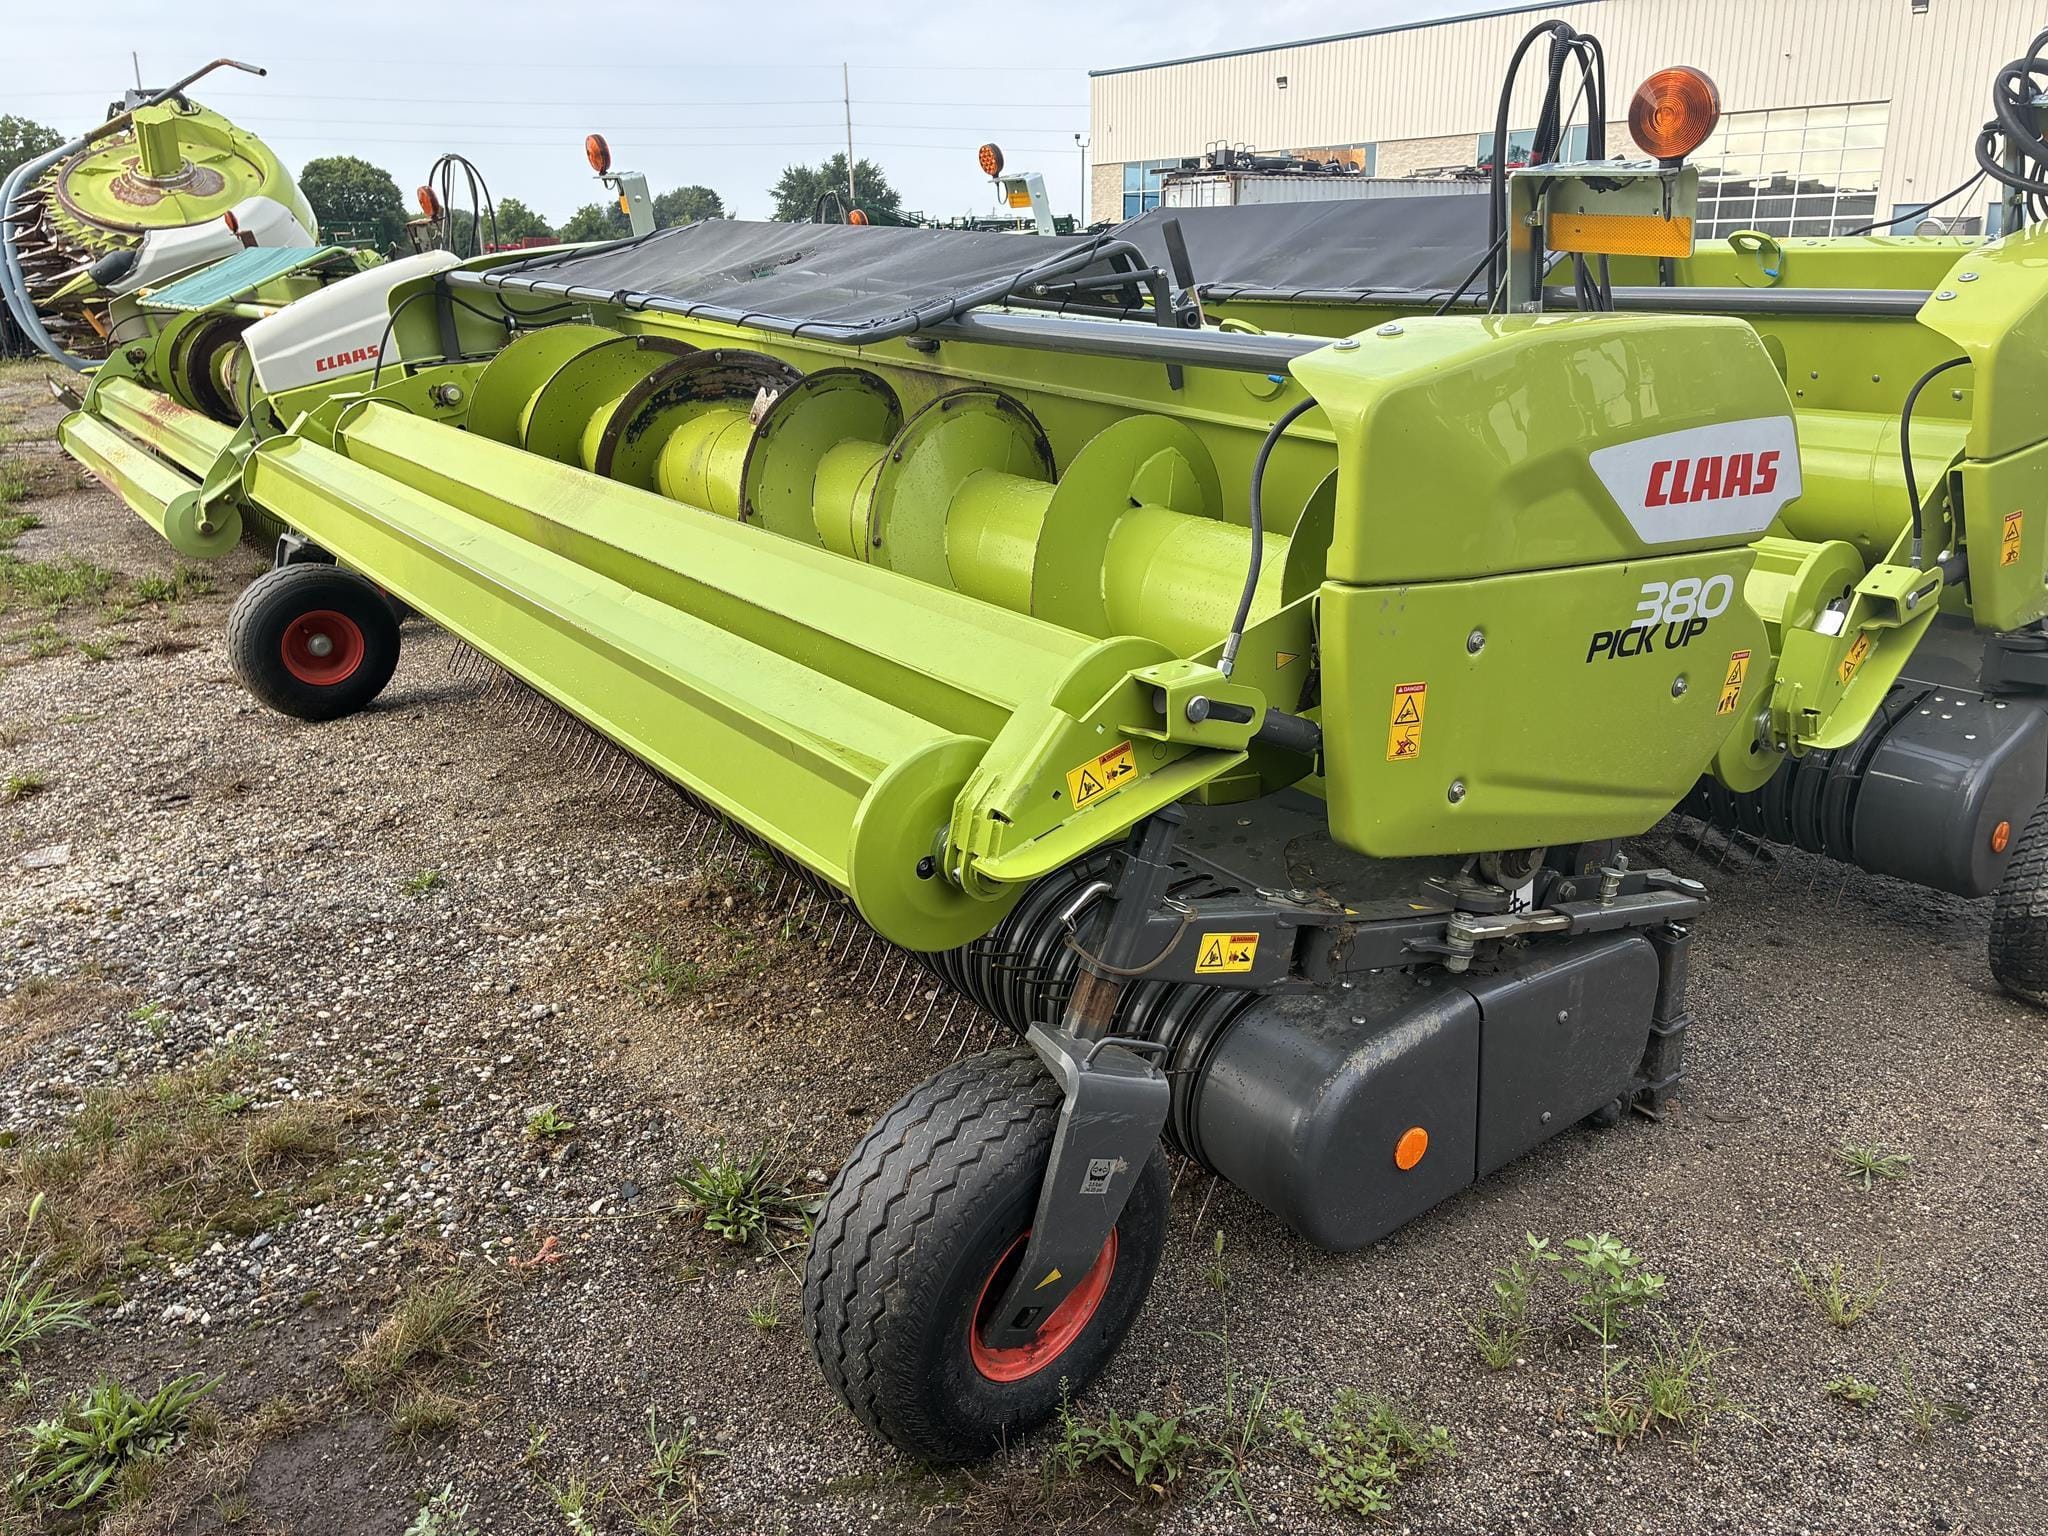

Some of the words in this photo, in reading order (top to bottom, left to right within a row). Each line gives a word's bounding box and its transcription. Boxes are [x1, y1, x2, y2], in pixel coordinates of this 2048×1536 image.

[316, 345, 379, 372] CLAAS
[1645, 451, 1780, 507] CLAAS
[1631, 574, 1734, 628] 380
[1586, 623, 1661, 663] PICK
[1665, 617, 1709, 649] UP
[1403, 685, 1424, 693] DANGER
